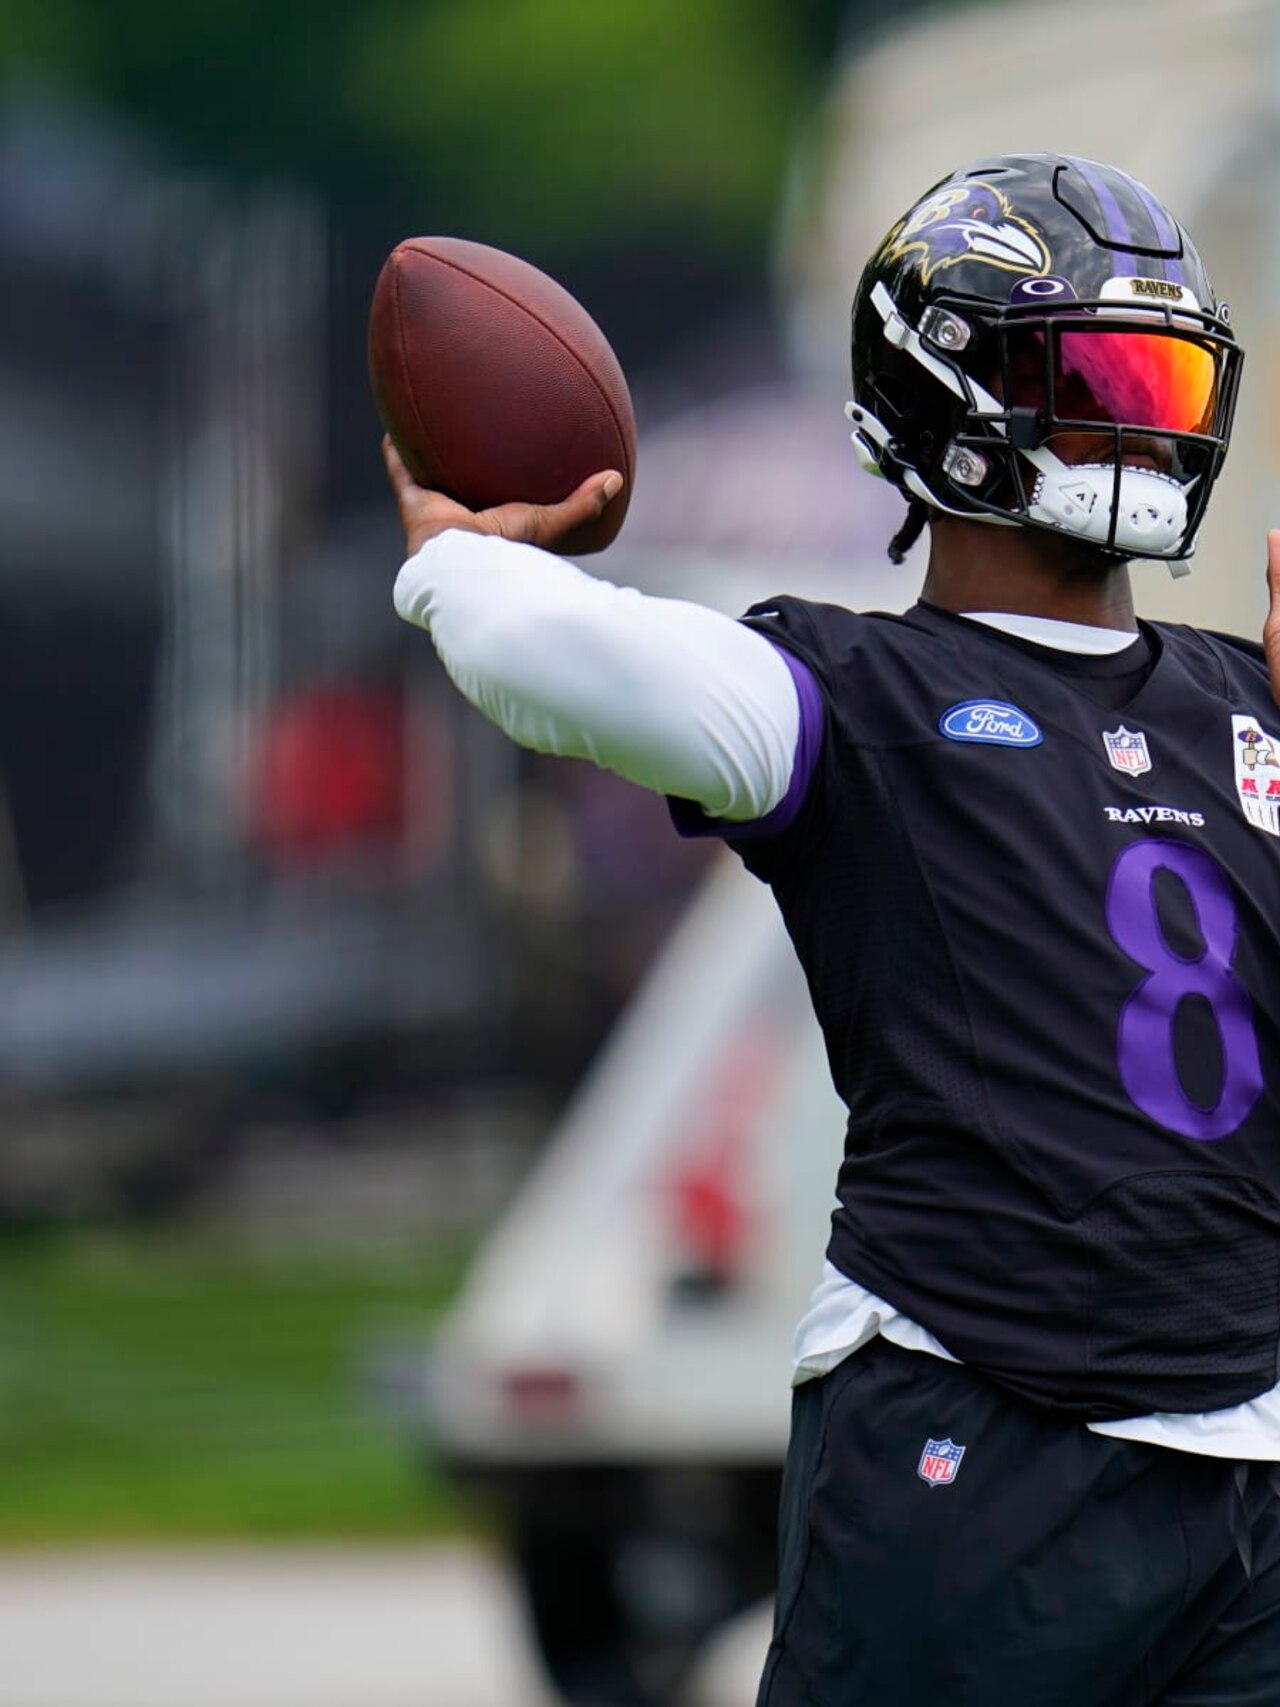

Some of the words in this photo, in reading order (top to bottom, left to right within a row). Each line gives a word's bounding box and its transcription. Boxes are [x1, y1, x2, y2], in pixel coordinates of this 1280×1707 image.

[1130, 279, 1183, 301] RAVENS
[966, 707, 1024, 738] Ford
[1115, 750, 1145, 767] NFL
[1103, 806, 1205, 827] RAVENS
[1105, 838, 1264, 1141] 8
[922, 1455, 953, 1479] NFL
